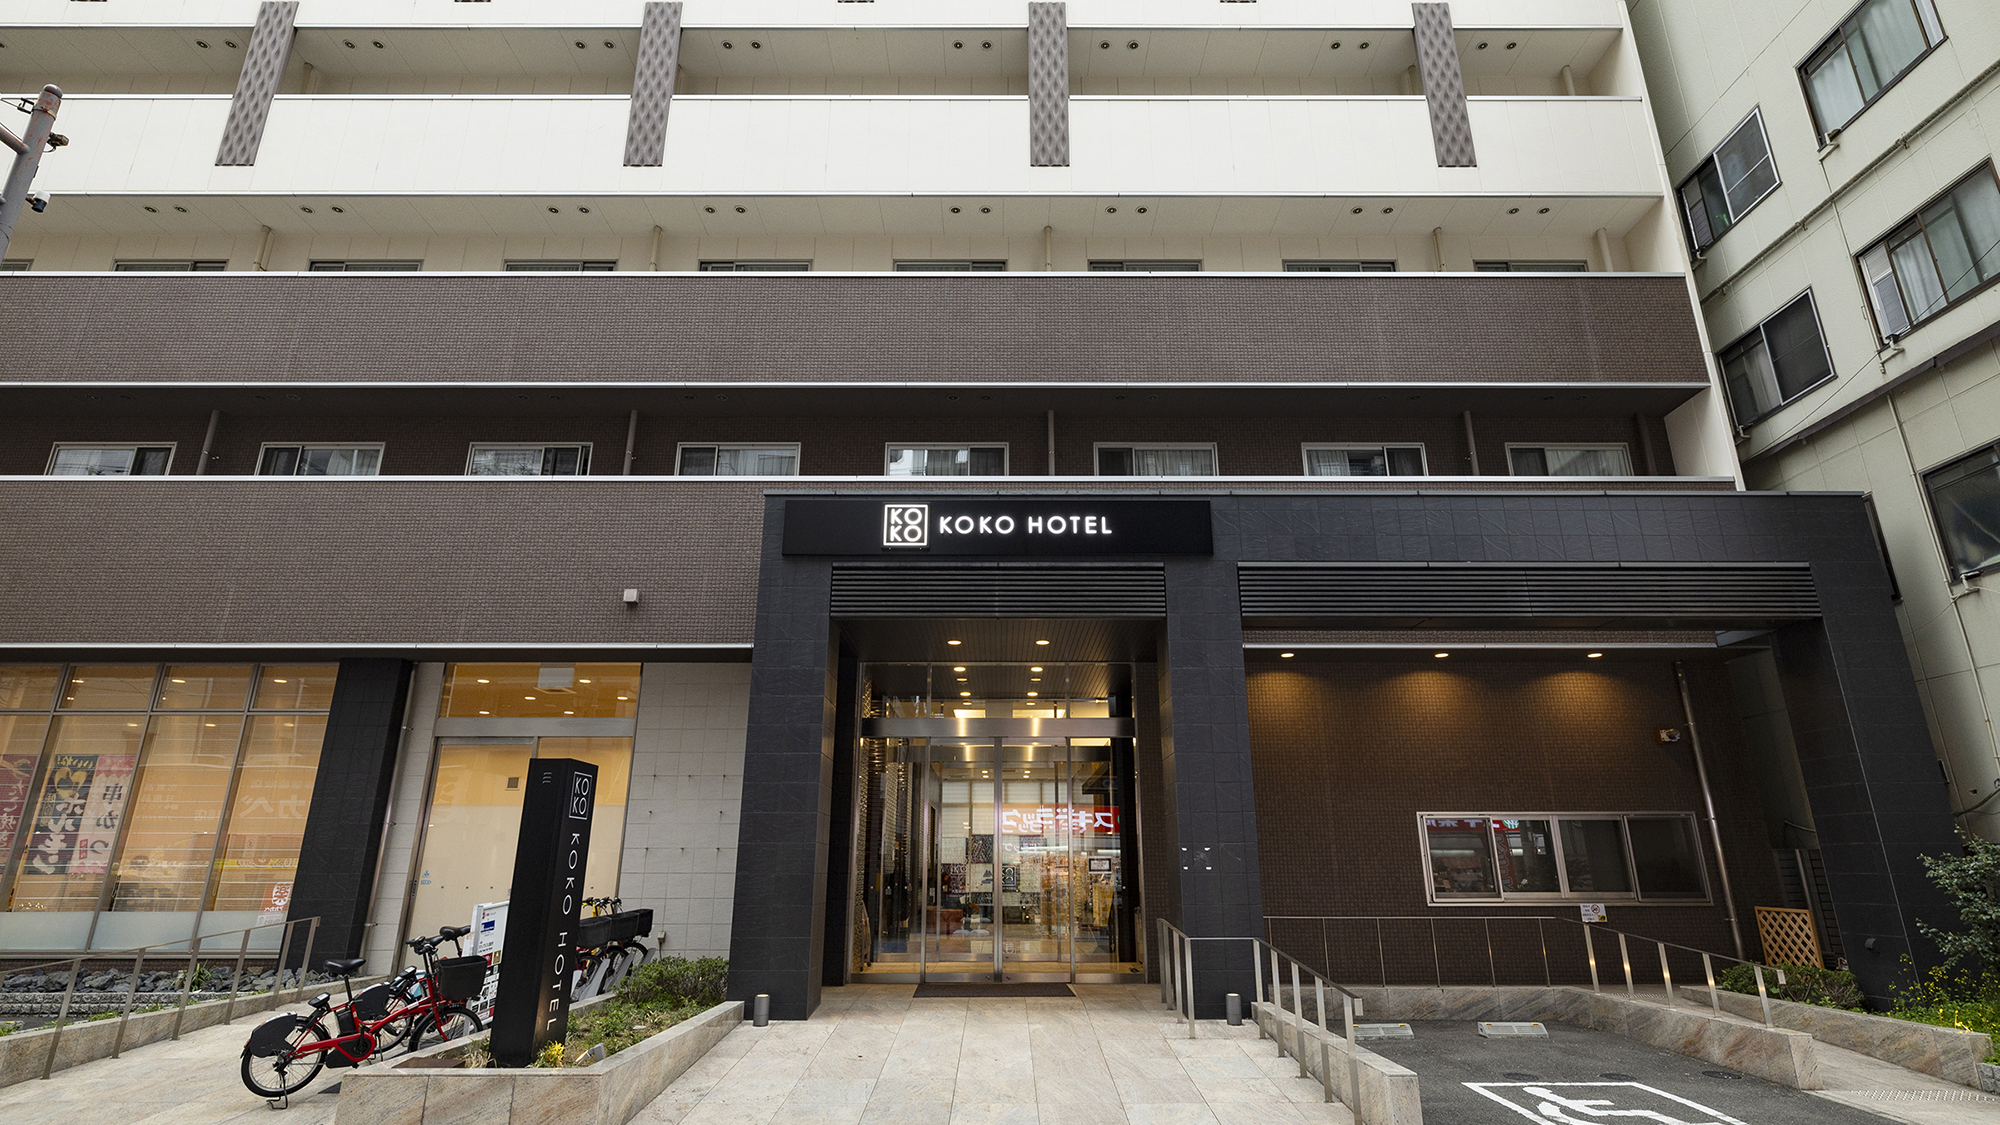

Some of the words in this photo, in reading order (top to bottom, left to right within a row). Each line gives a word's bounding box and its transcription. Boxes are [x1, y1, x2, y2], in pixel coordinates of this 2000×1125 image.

[890, 508, 923, 525] KO
[939, 516, 1014, 534] KOKO
[1028, 516, 1112, 534] HOTEL
[890, 525, 923, 542] KO
[574, 777, 590, 797] KO
[572, 796, 588, 816] KO
[563, 833, 580, 915] KOKO
[547, 932, 567, 1031] HOTEL
